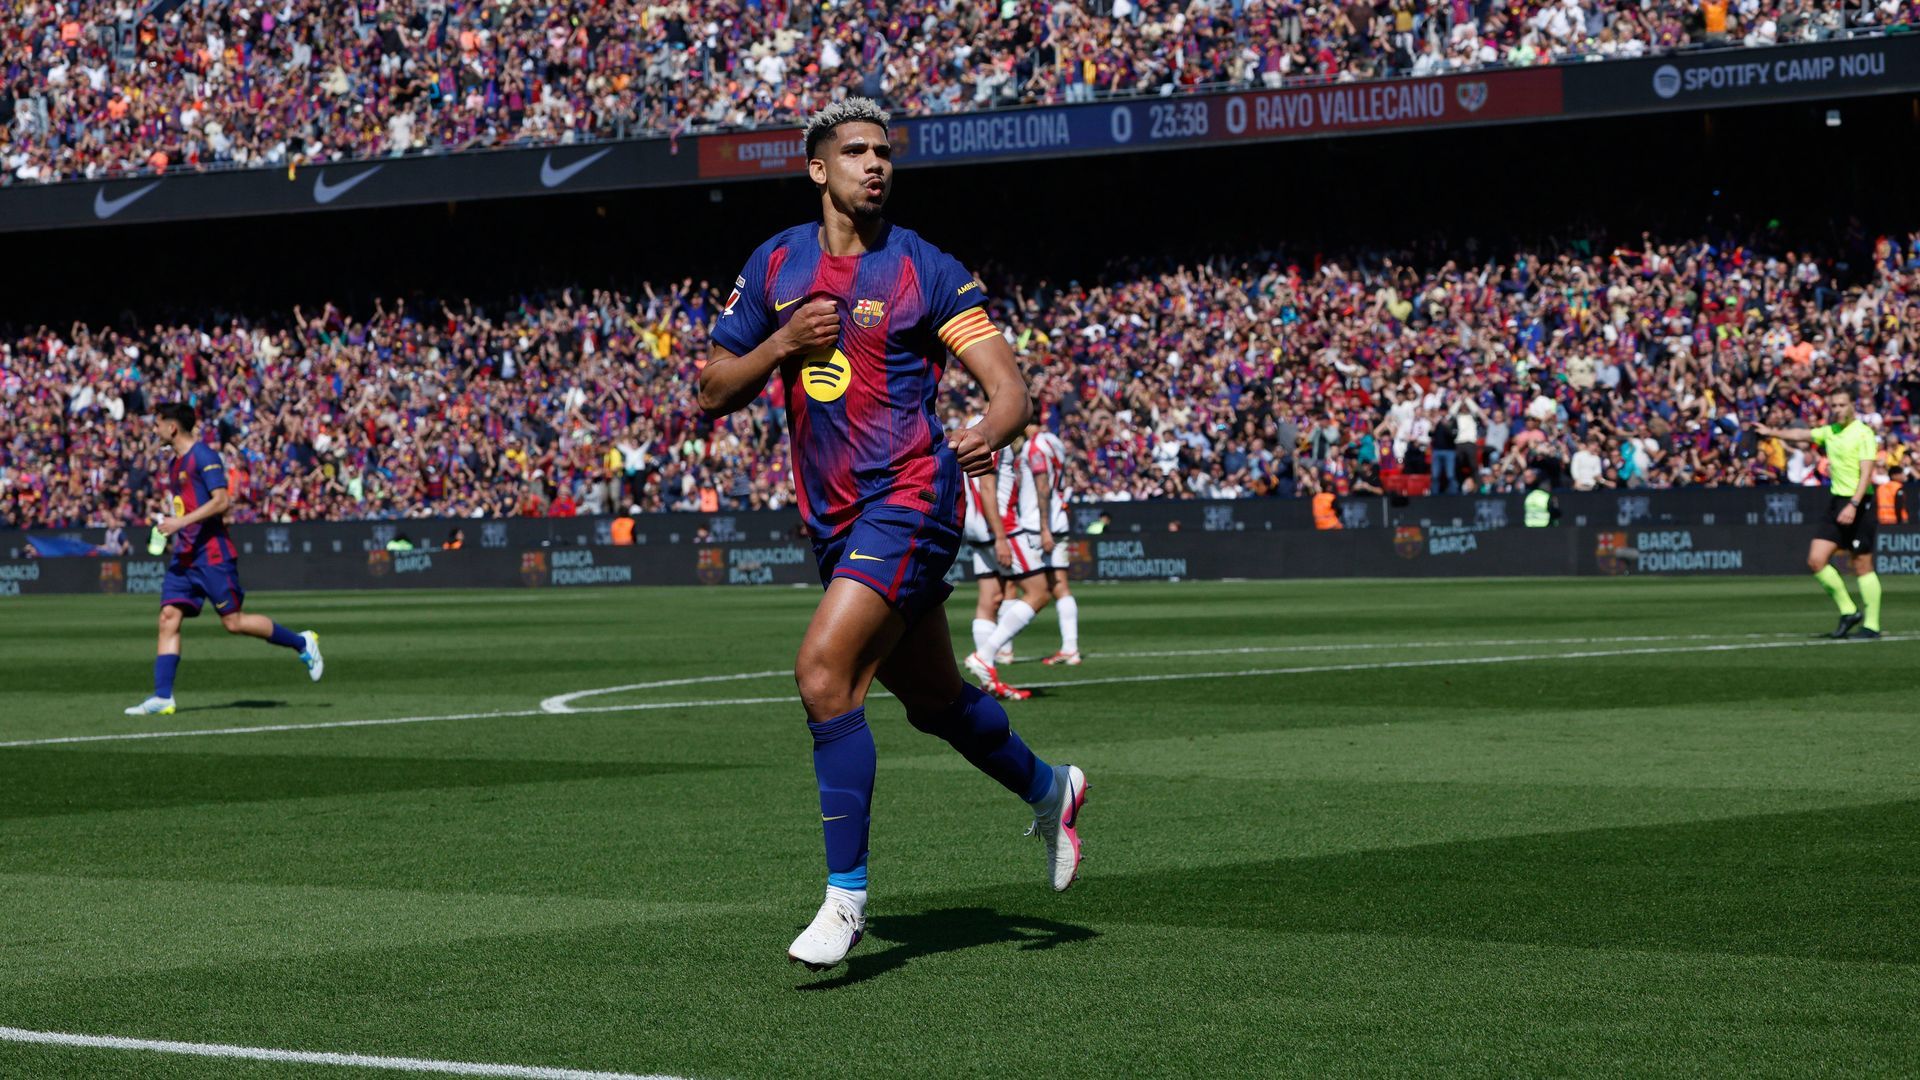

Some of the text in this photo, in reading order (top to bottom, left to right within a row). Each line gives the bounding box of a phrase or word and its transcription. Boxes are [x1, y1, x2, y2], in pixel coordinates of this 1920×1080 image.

[1684, 52, 1885, 91] SPOTIFY CAMP NOU
[919, 122, 944, 156] FC
[950, 113, 1070, 153] BARCELONA
[1111, 105, 1133, 144] 0
[1226, 96, 1248, 135] 0
[1255, 93, 1314, 131] RAYO
[1318, 82, 1445, 126] VALLECANO
[1097, 541, 1145, 559] BARÇA
[1428, 534, 1477, 555] BARÇA
[1638, 531, 1693, 552] BARÇA
[551, 550, 594, 568] BARÇA
[1098, 558, 1187, 577] FOUNDATION
[1638, 550, 1743, 571] FOUNDATION
[551, 565, 632, 584] FOUNDATION
[729, 566, 773, 584] BAÇA
